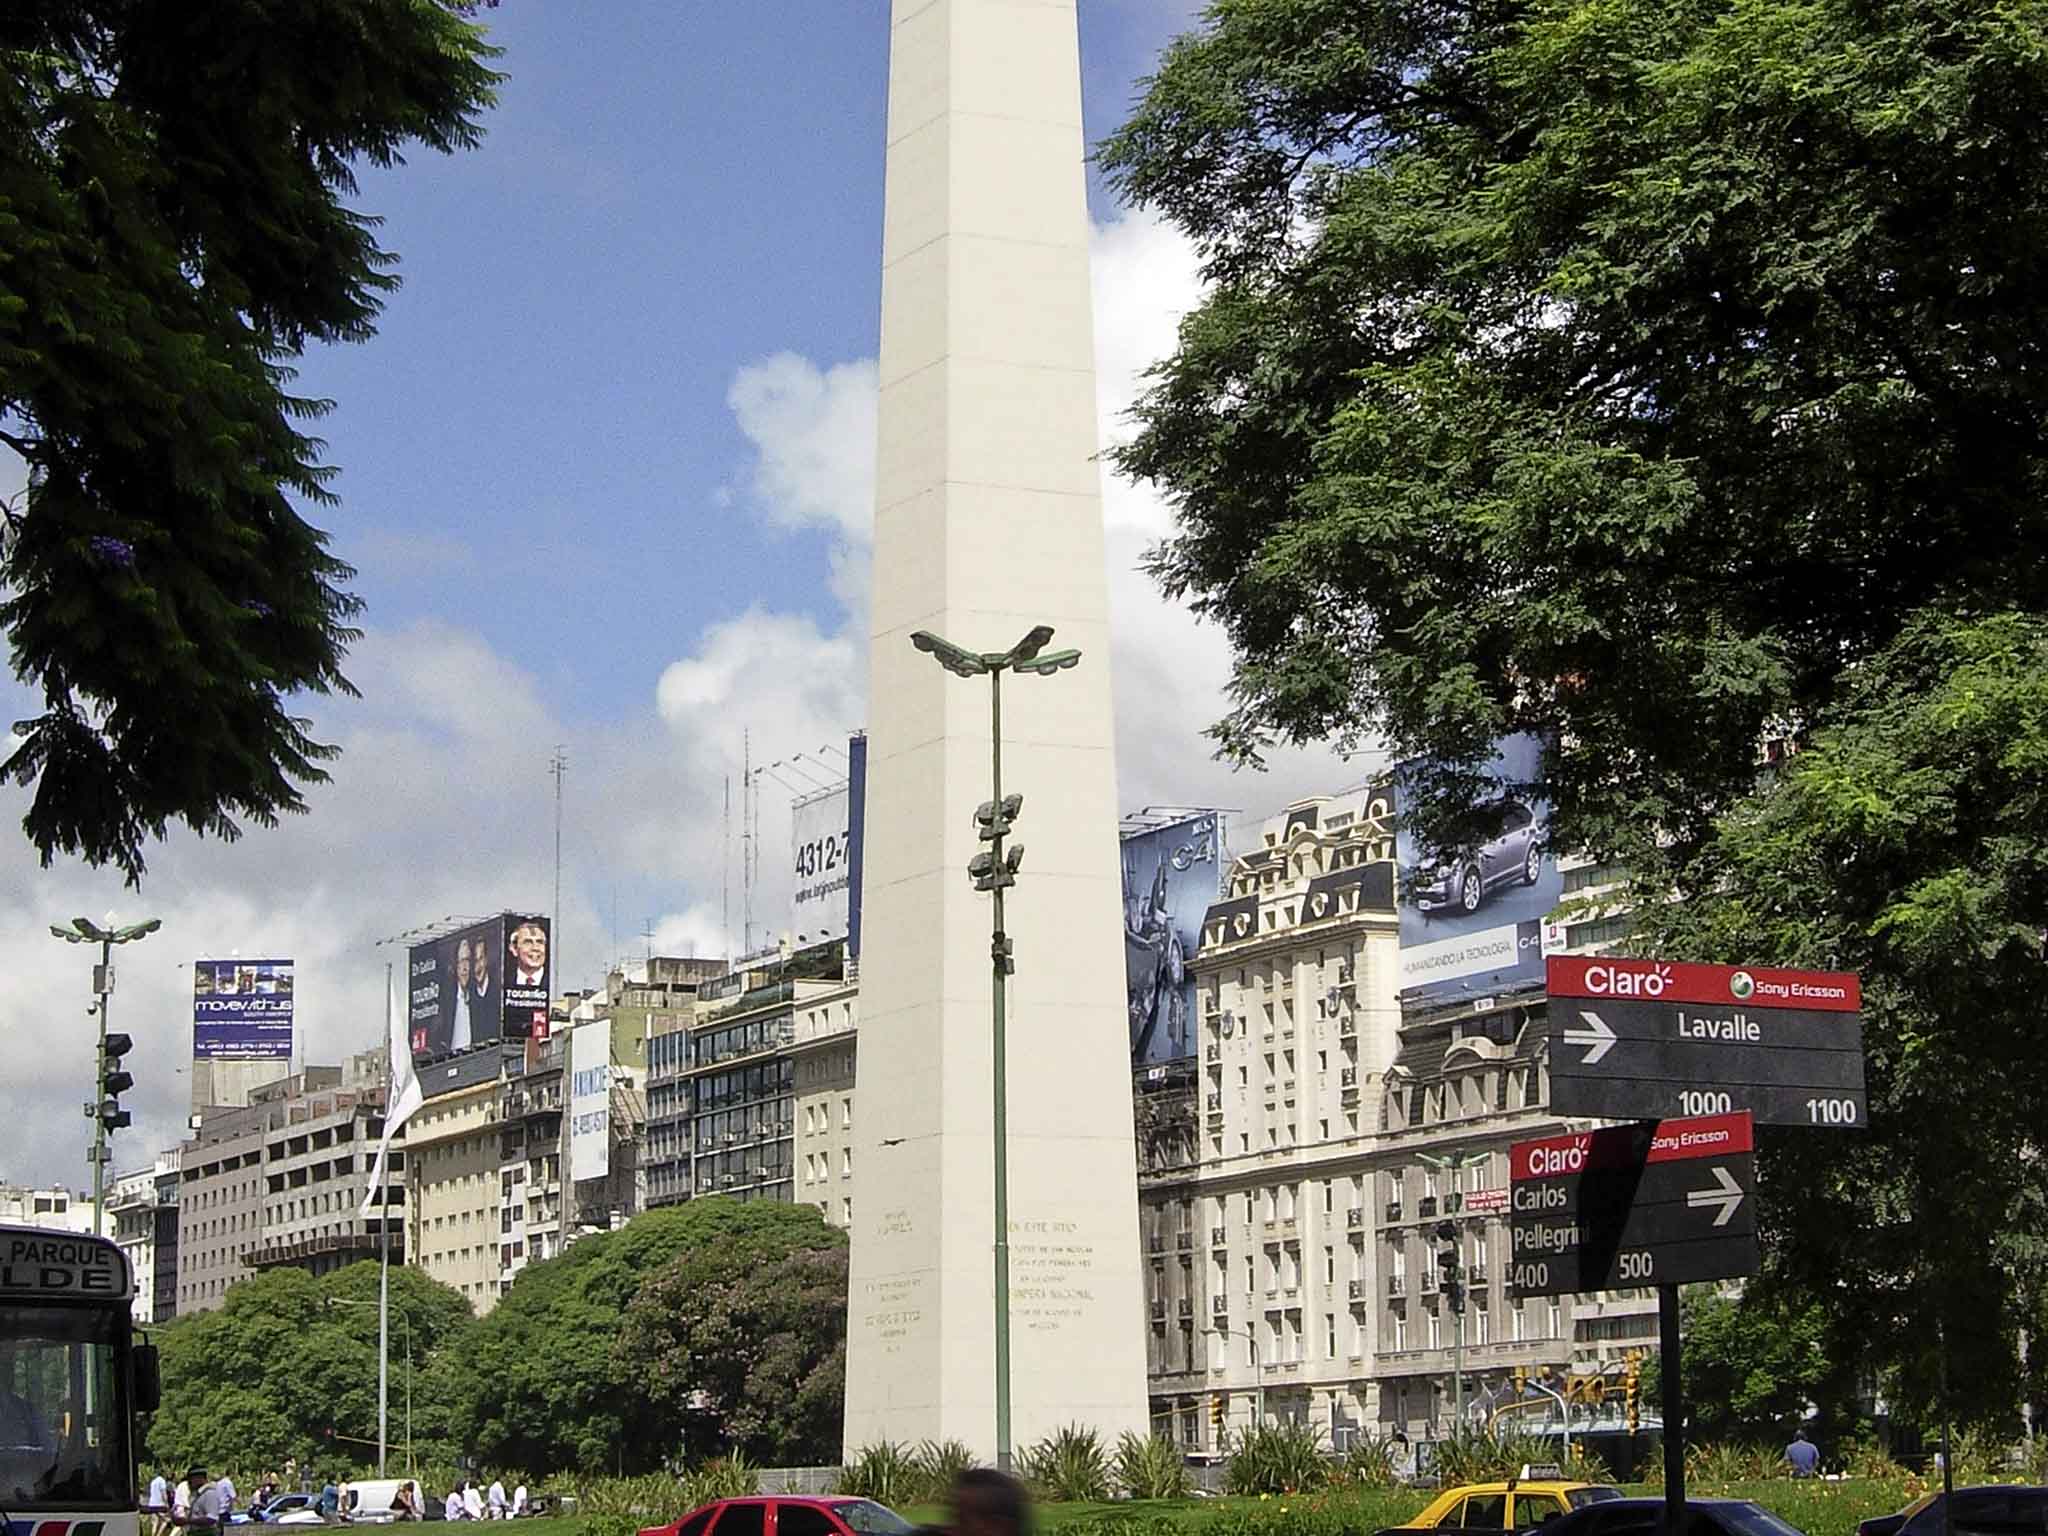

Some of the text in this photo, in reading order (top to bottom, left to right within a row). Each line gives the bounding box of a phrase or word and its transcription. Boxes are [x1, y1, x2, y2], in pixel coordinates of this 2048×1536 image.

[1171, 836, 1215, 871] C4
[1519, 935, 1539, 949] C4
[1584, 965, 1667, 996] Claro
[1757, 980, 1845, 998] Sony Ericsson
[1678, 1012, 1761, 1041] Lavalle
[1678, 1091, 1731, 1116] 1000
[1806, 1098, 1857, 1124] 1100
[1650, 1129, 1729, 1151] Sony Ericsson
[1529, 1145, 1584, 1175] Claro
[1513, 1185, 1567, 1212] Carlos
[11, 1240, 110, 1265] PARQUE
[1514, 1263, 1549, 1289] 400
[1618, 1253, 1653, 1280] 500
